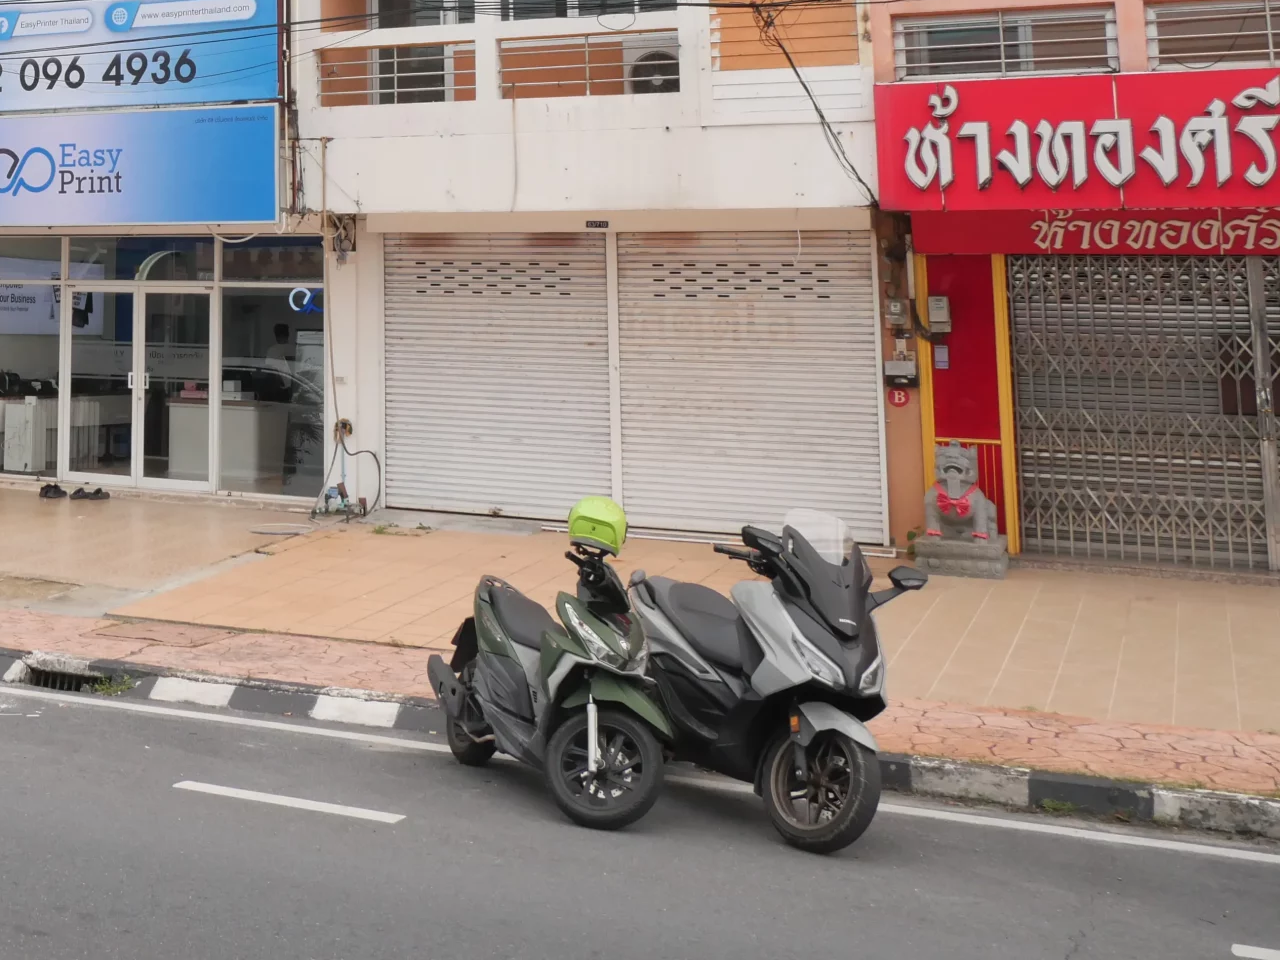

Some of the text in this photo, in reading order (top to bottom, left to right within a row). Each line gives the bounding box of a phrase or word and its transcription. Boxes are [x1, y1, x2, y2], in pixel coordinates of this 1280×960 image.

[140, 3, 250, 21] www.easyprinterthailand.com
[20, 15, 89, 31] EasyPrinter Thailand
[19, 55, 86, 92] 096
[102, 48, 197, 87] 4936
[58, 143, 123, 174] Easy
[58, 170, 123, 195] Print
[10, 293, 36, 304] Business
[893, 390, 906, 403] B
